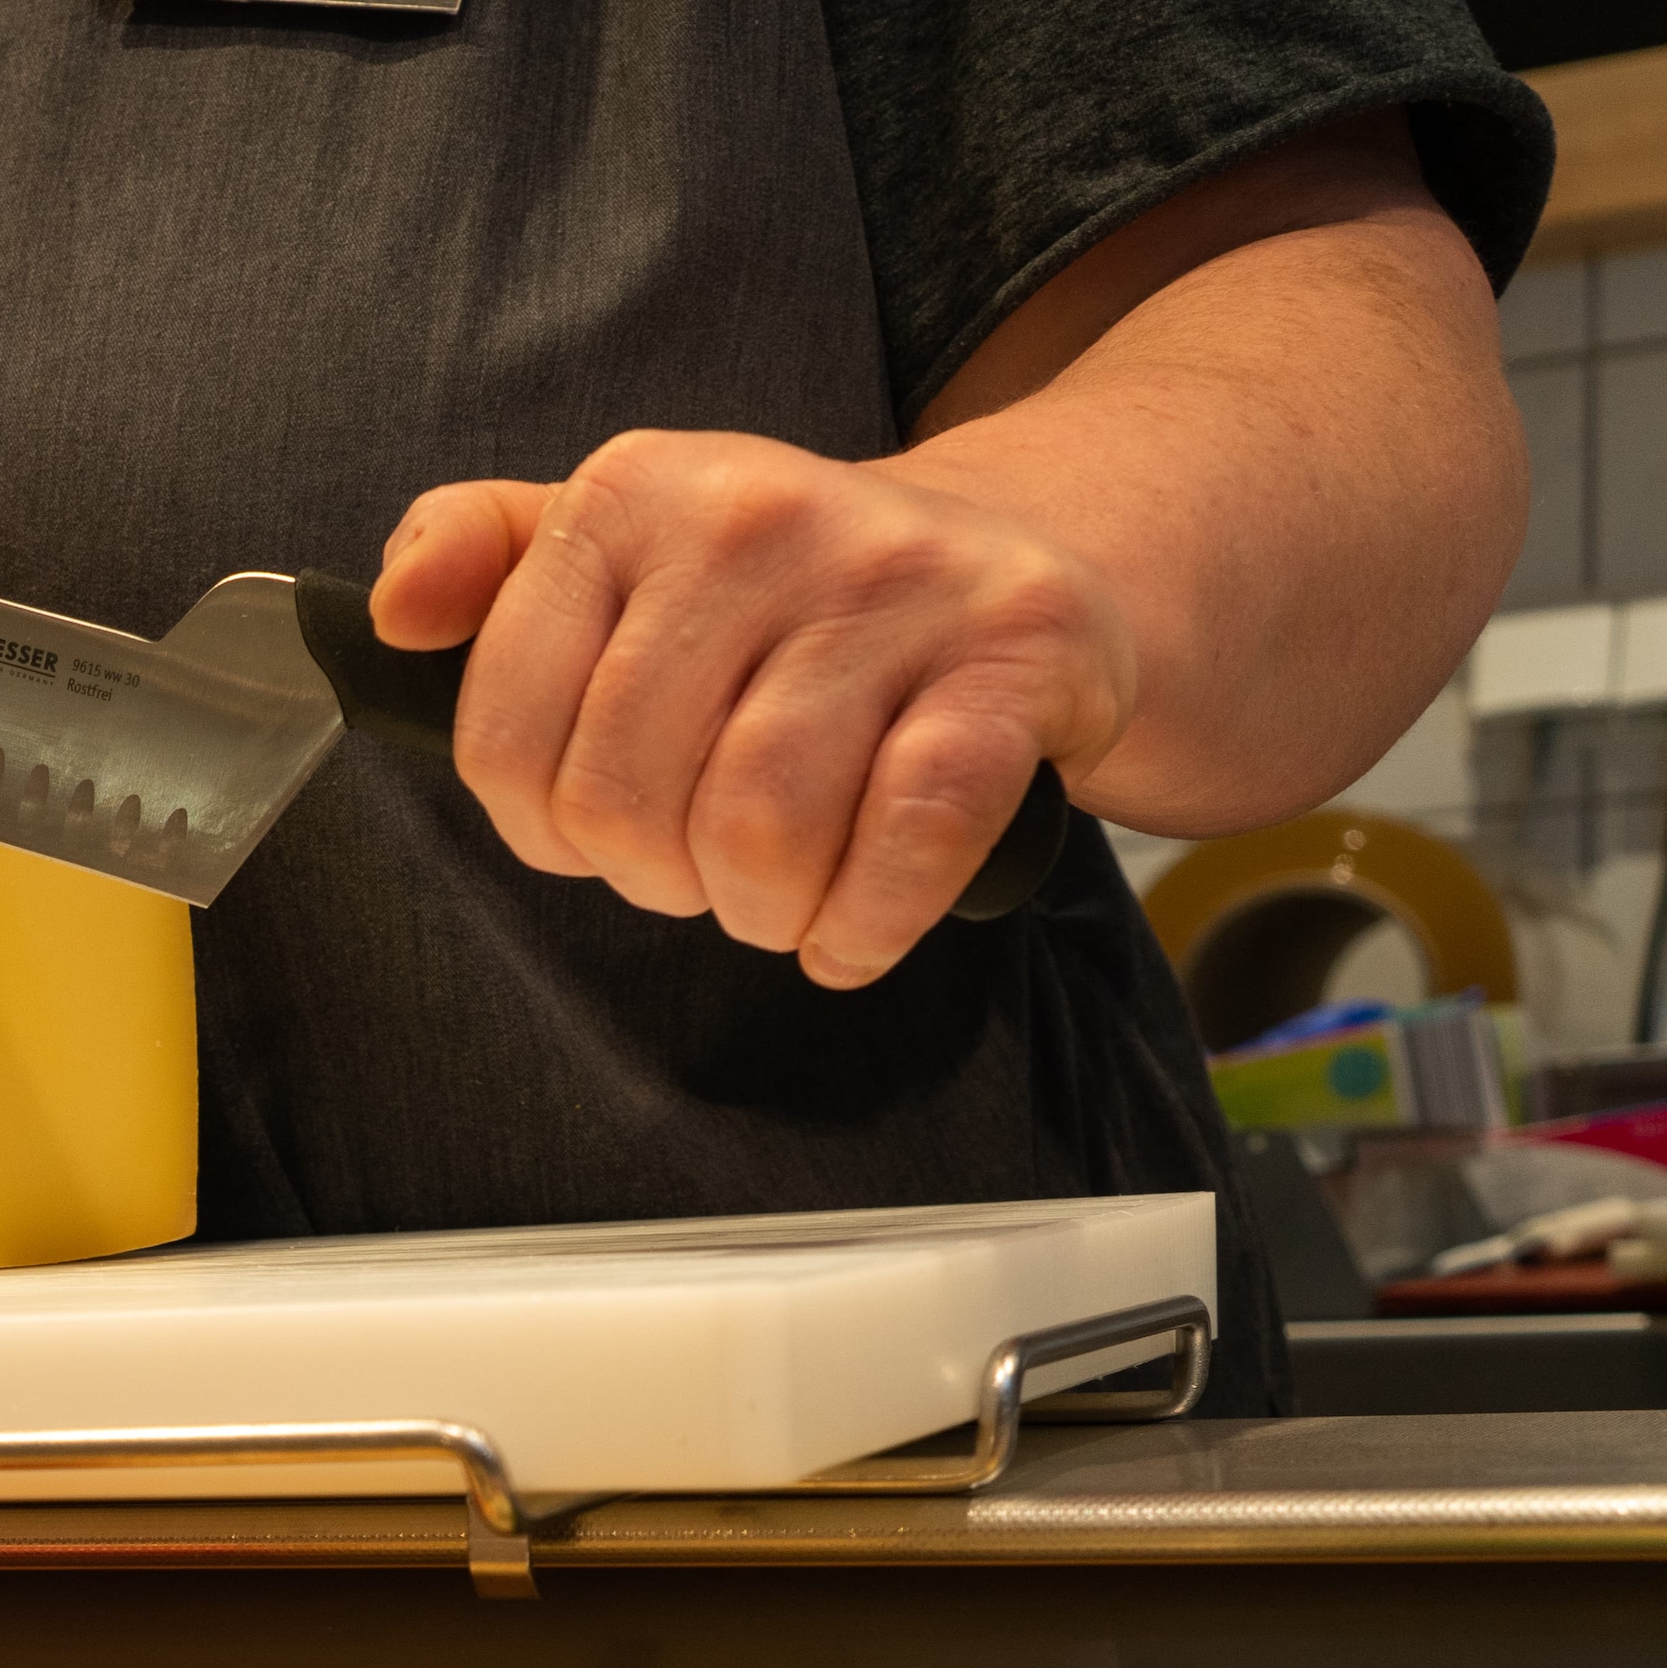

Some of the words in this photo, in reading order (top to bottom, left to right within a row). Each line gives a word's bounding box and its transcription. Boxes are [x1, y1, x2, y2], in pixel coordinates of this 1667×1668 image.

[10, 670, 54, 686] GERMANY
[72, 659, 101, 677] 9615
[124, 672, 140, 688] 30
[67, 678, 113, 701] Rostfrei
